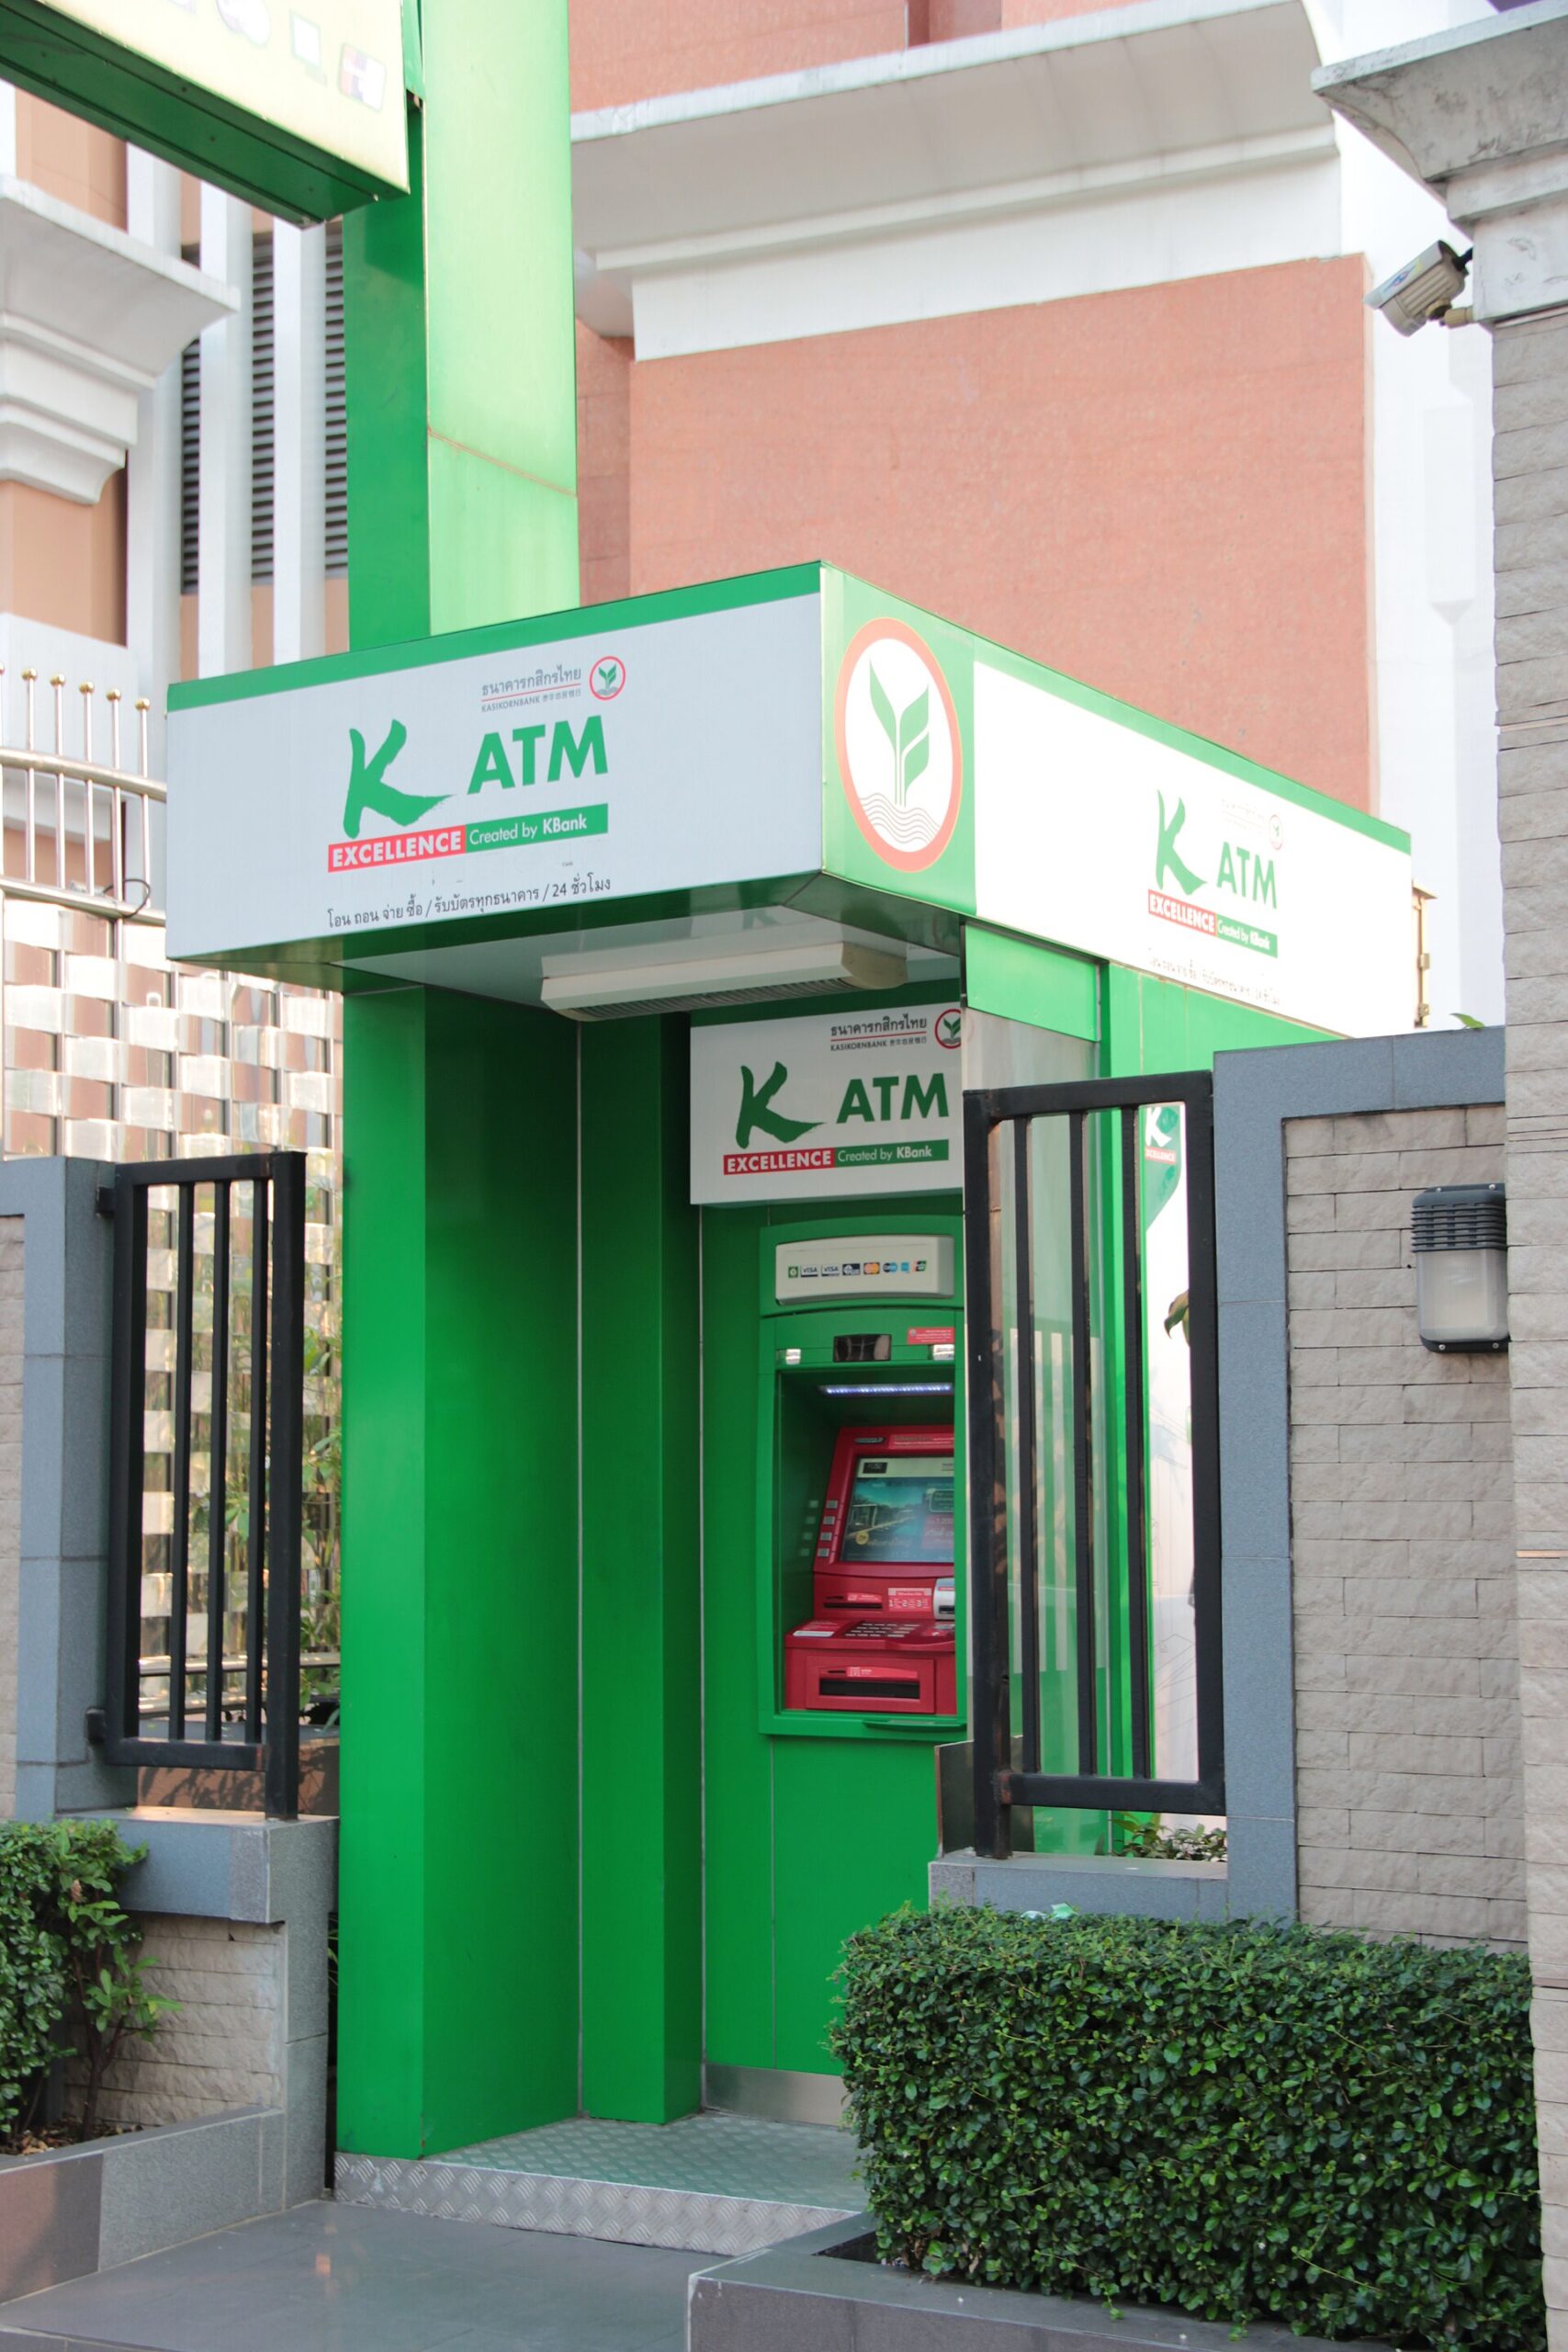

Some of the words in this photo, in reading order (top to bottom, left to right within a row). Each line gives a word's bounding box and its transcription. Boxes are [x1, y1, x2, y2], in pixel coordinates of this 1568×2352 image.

[482, 664, 581, 696] ธนาคารกสิกรไทย
[481, 695, 540, 713] KASIKORNBANK
[343, 718, 457, 840] K
[467, 715, 608, 795] ATM
[333, 831, 461, 868] EXCELLENCE
[469, 822, 518, 845] Created
[523, 820, 537, 839] by
[543, 814, 587, 834] KBank
[1156, 788, 1208, 895] K
[1216, 841, 1277, 910] ATM
[328, 909, 351, 929] โอน
[355, 910, 379, 925] ถอน
[382, 904, 403, 921] จ่าย
[406, 893, 423, 918] ซื้อ
[434, 889, 539, 914] รับบัตรทุกธนาคาร
[552, 883, 568, 898] 24
[570, 872, 611, 895] ชั่วโมง
[1150, 894, 1214, 933] EXCELLENCE
[830, 1013, 927, 1036] ธนาคารกสิกรไทย
[830, 1039, 887, 1052] KASIKORNBANK
[736, 1060, 828, 1149] K
[836, 1072, 949, 1124] ATM
[727, 1150, 831, 1172] EXCELLENCE
[838, 1149, 878, 1163] Created
[880, 1148, 893, 1161] by
[897, 1146, 932, 1159] KBank
[1145, 1148, 1175, 1162] XCELLENCE
